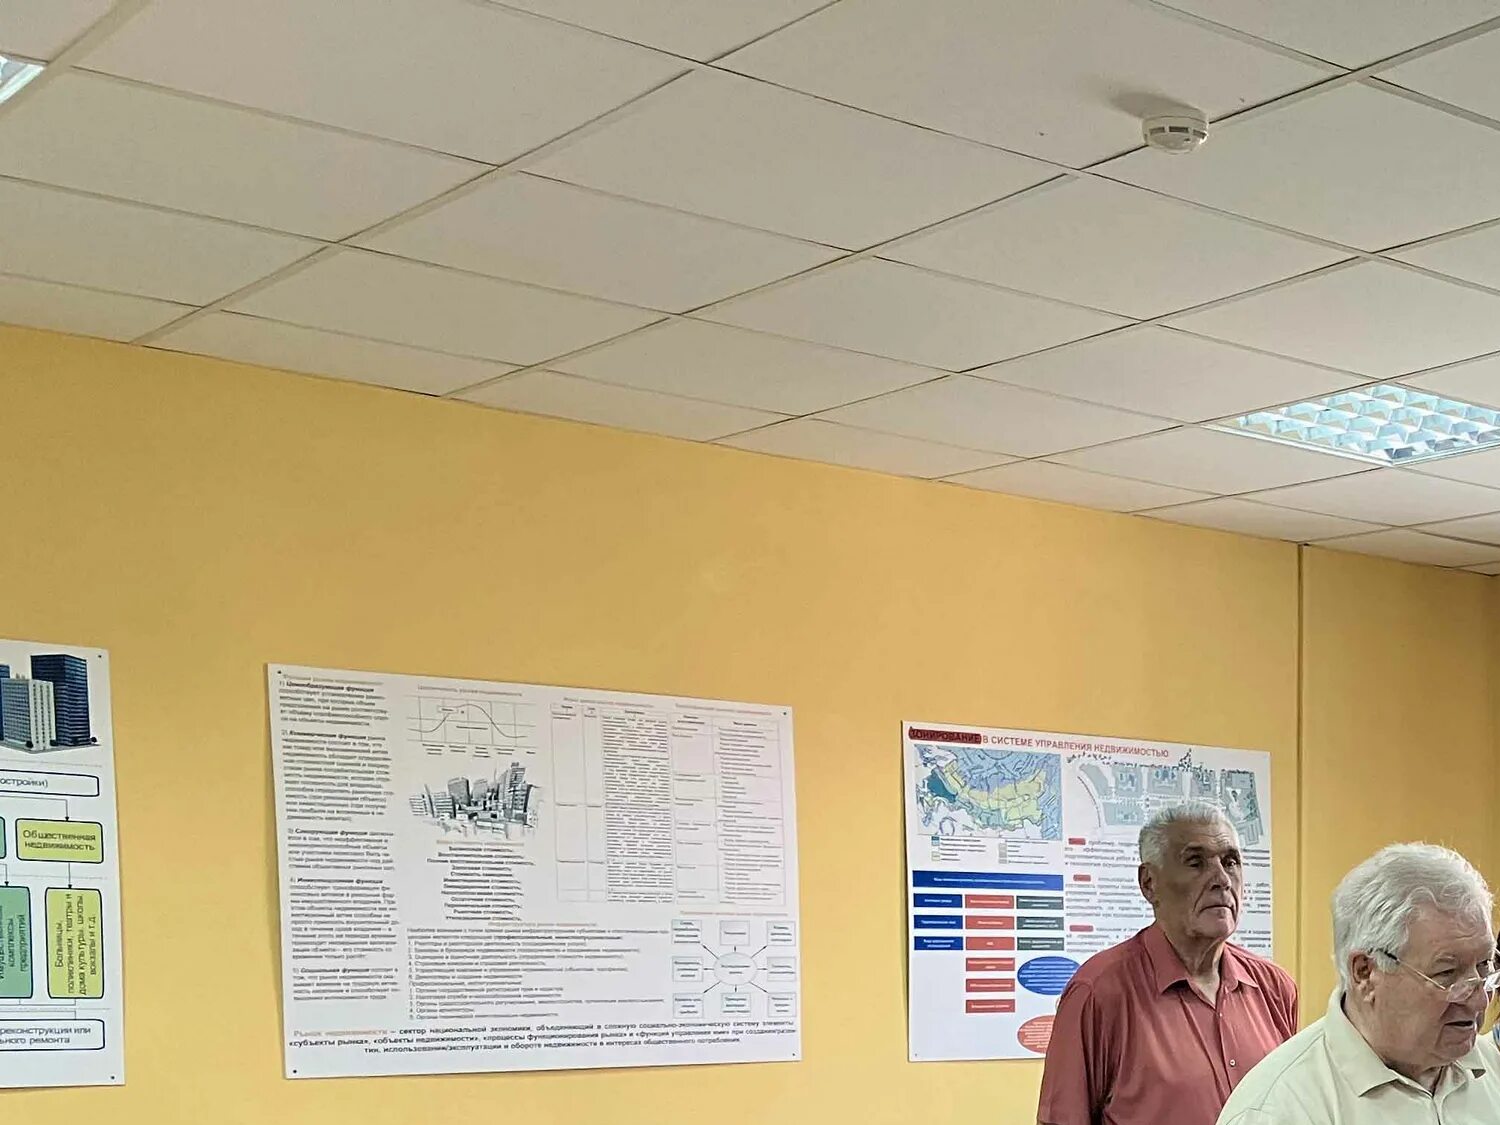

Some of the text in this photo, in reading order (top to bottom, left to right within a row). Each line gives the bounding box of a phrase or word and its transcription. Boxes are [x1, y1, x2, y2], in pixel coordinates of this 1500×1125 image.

[983, 735, 989, 743] В
[991, 735, 1032, 747] СИСТЕМЕ
[1035, 739, 1092, 751] УПРАВЛЕНИЯ
[1094, 743, 1169, 757] НЕДВИЖИМОСТЬЮ
[23, 829, 96, 841] Общественная
[25, 841, 96, 851] недвижимость
[66, 901, 74, 932] театры
[7, 918, 15, 967] комплексы
[18, 915, 28, 972] предприятий
[78, 972, 87, 995] дома
[0, 1027, 72, 1036] реконструкции
[430, 1026, 487, 1034] национальной
[30, 1037, 70, 1045] ремонта
[511, 1042, 542, 1050] обороте
